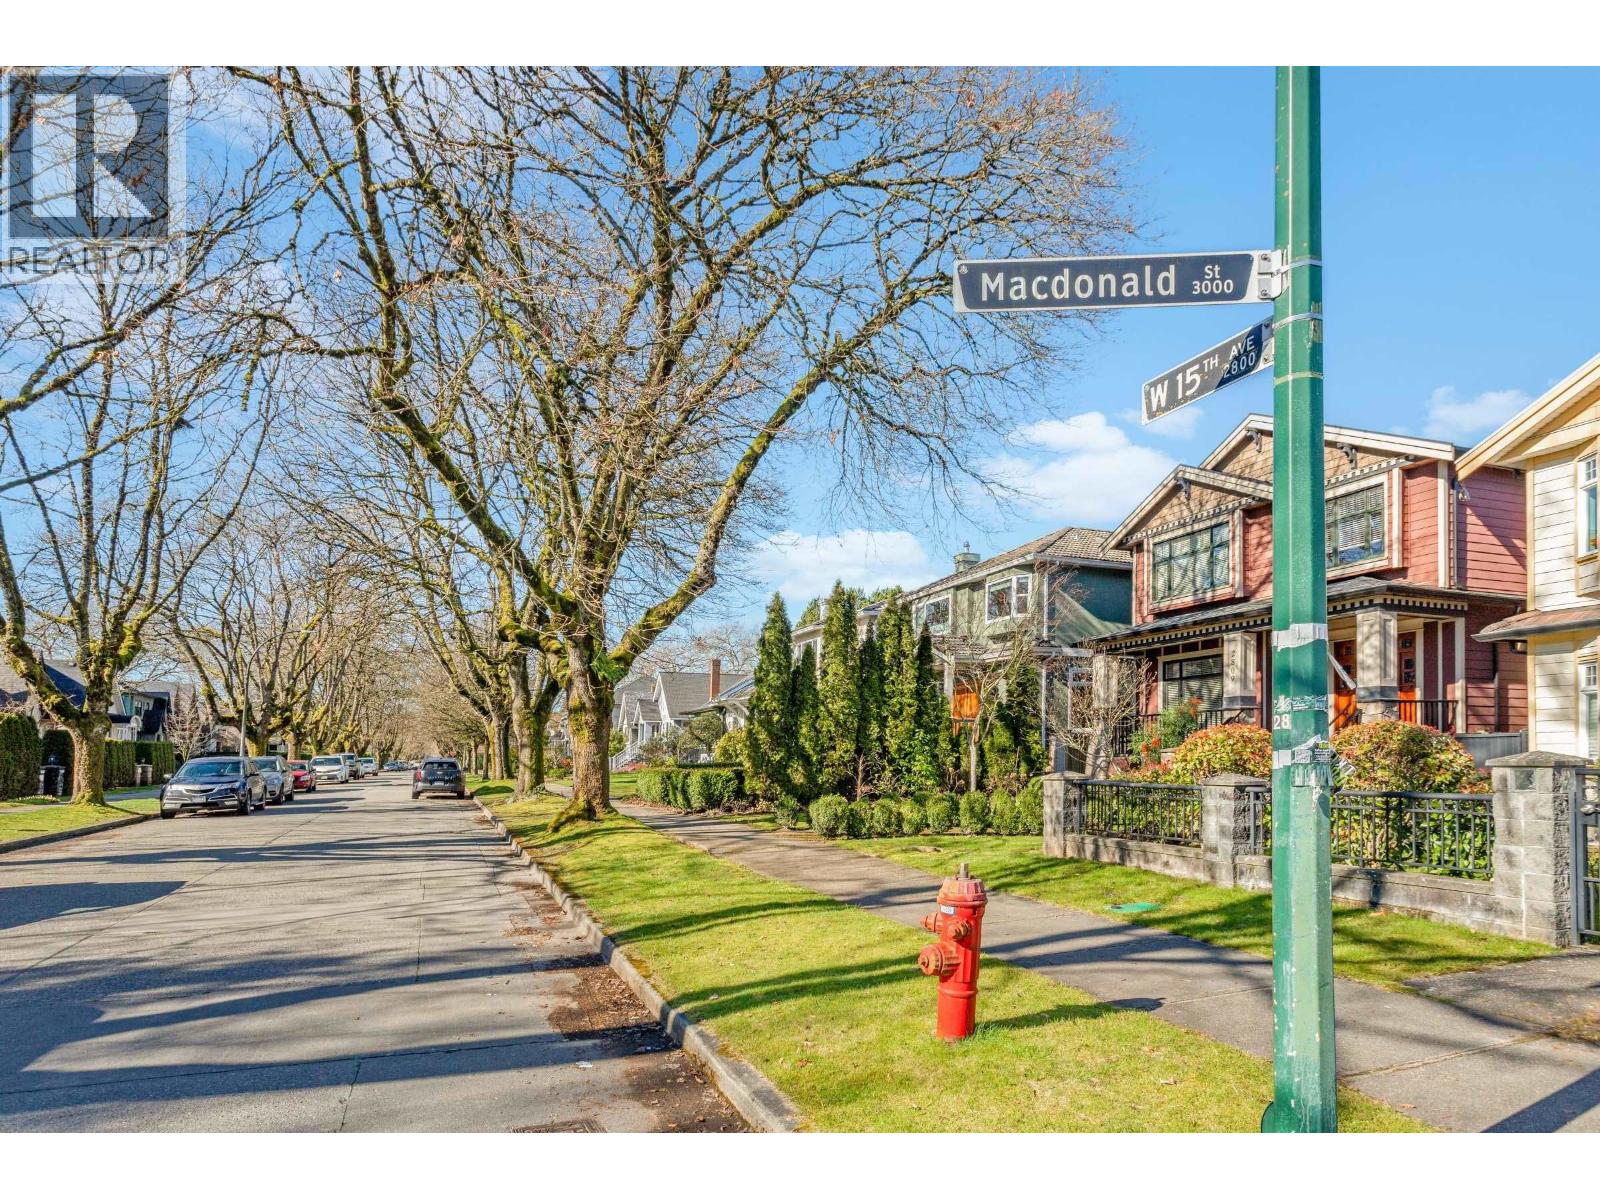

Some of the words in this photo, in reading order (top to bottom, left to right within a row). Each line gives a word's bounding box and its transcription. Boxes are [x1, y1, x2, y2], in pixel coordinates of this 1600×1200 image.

[981, 265, 1176, 302] Macdonald
[1204, 264, 1221, 279] St
[1192, 280, 1234, 295] 3000
[1150, 380, 1168, 412] W
[1229, 335, 1255, 360] AVE
[1222, 353, 1256, 378] 2800
[1273, 714, 1290, 730] 28
